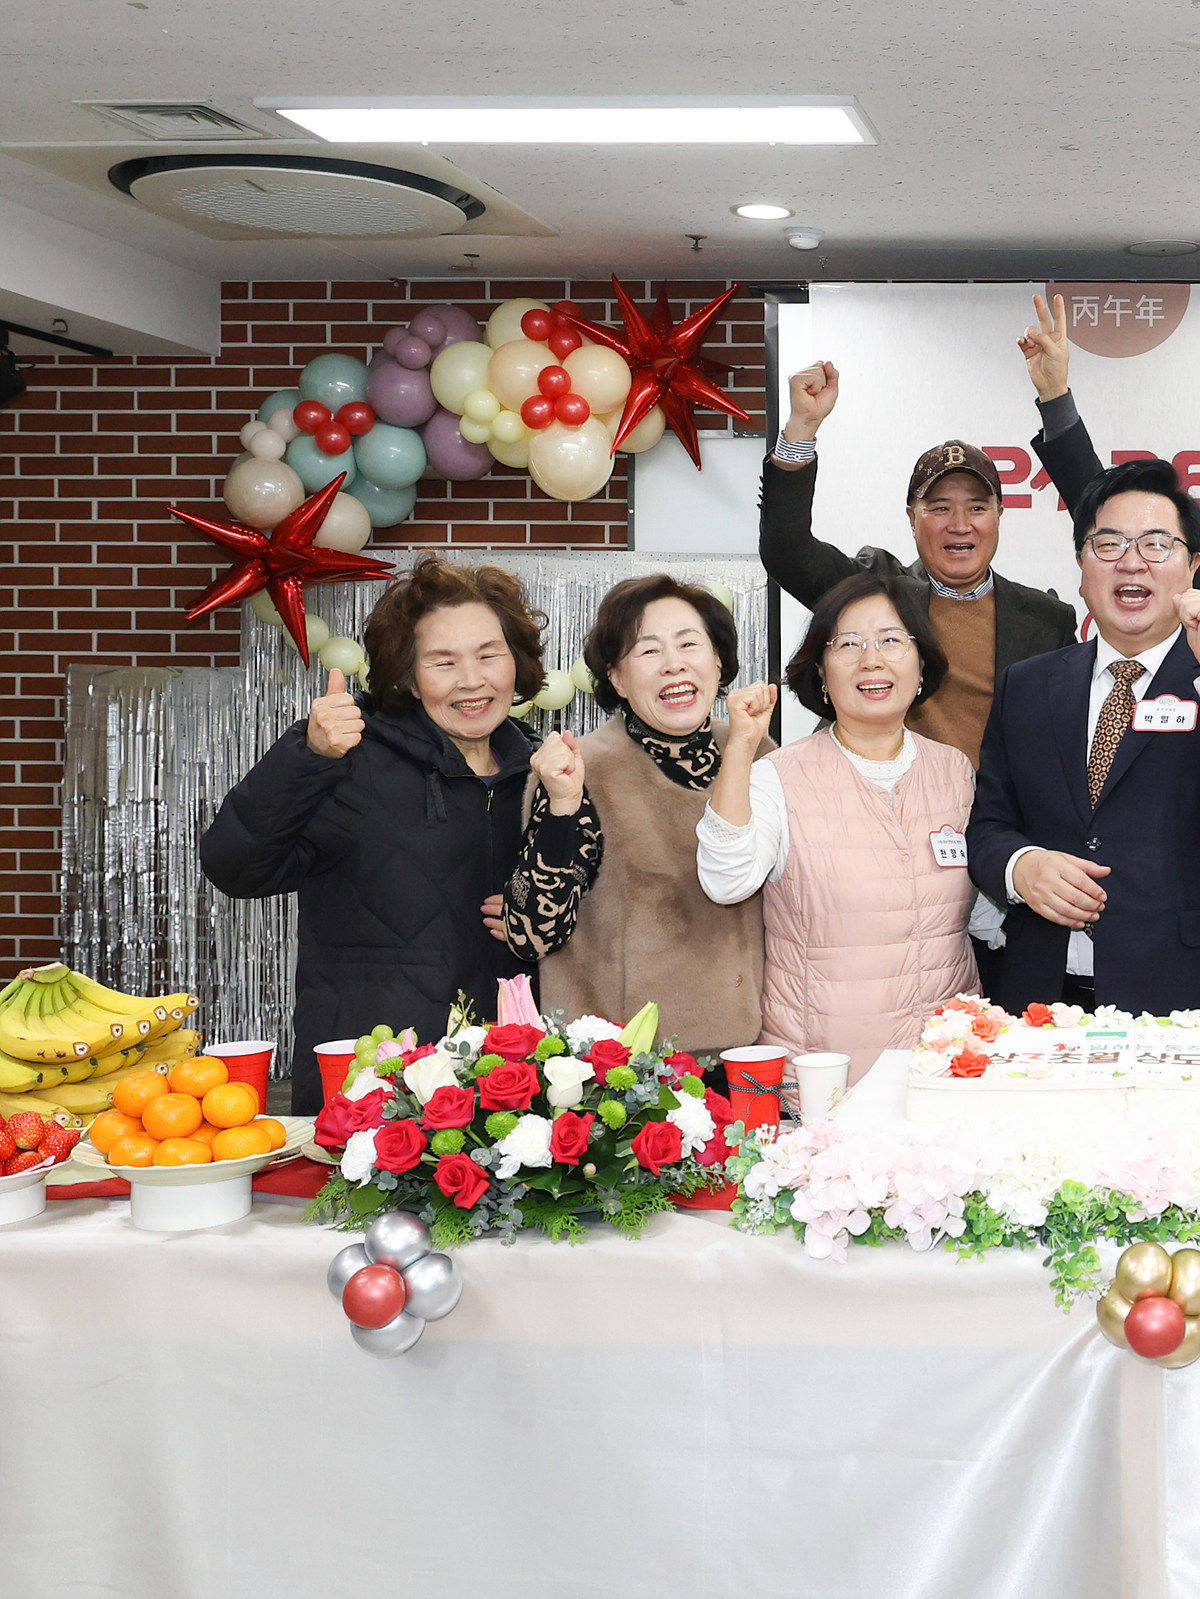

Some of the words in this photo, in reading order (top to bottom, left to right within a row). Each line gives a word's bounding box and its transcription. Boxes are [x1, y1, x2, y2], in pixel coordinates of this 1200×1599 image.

[1071, 294, 1165, 328] 丙午年
[943, 445, 967, 467] B
